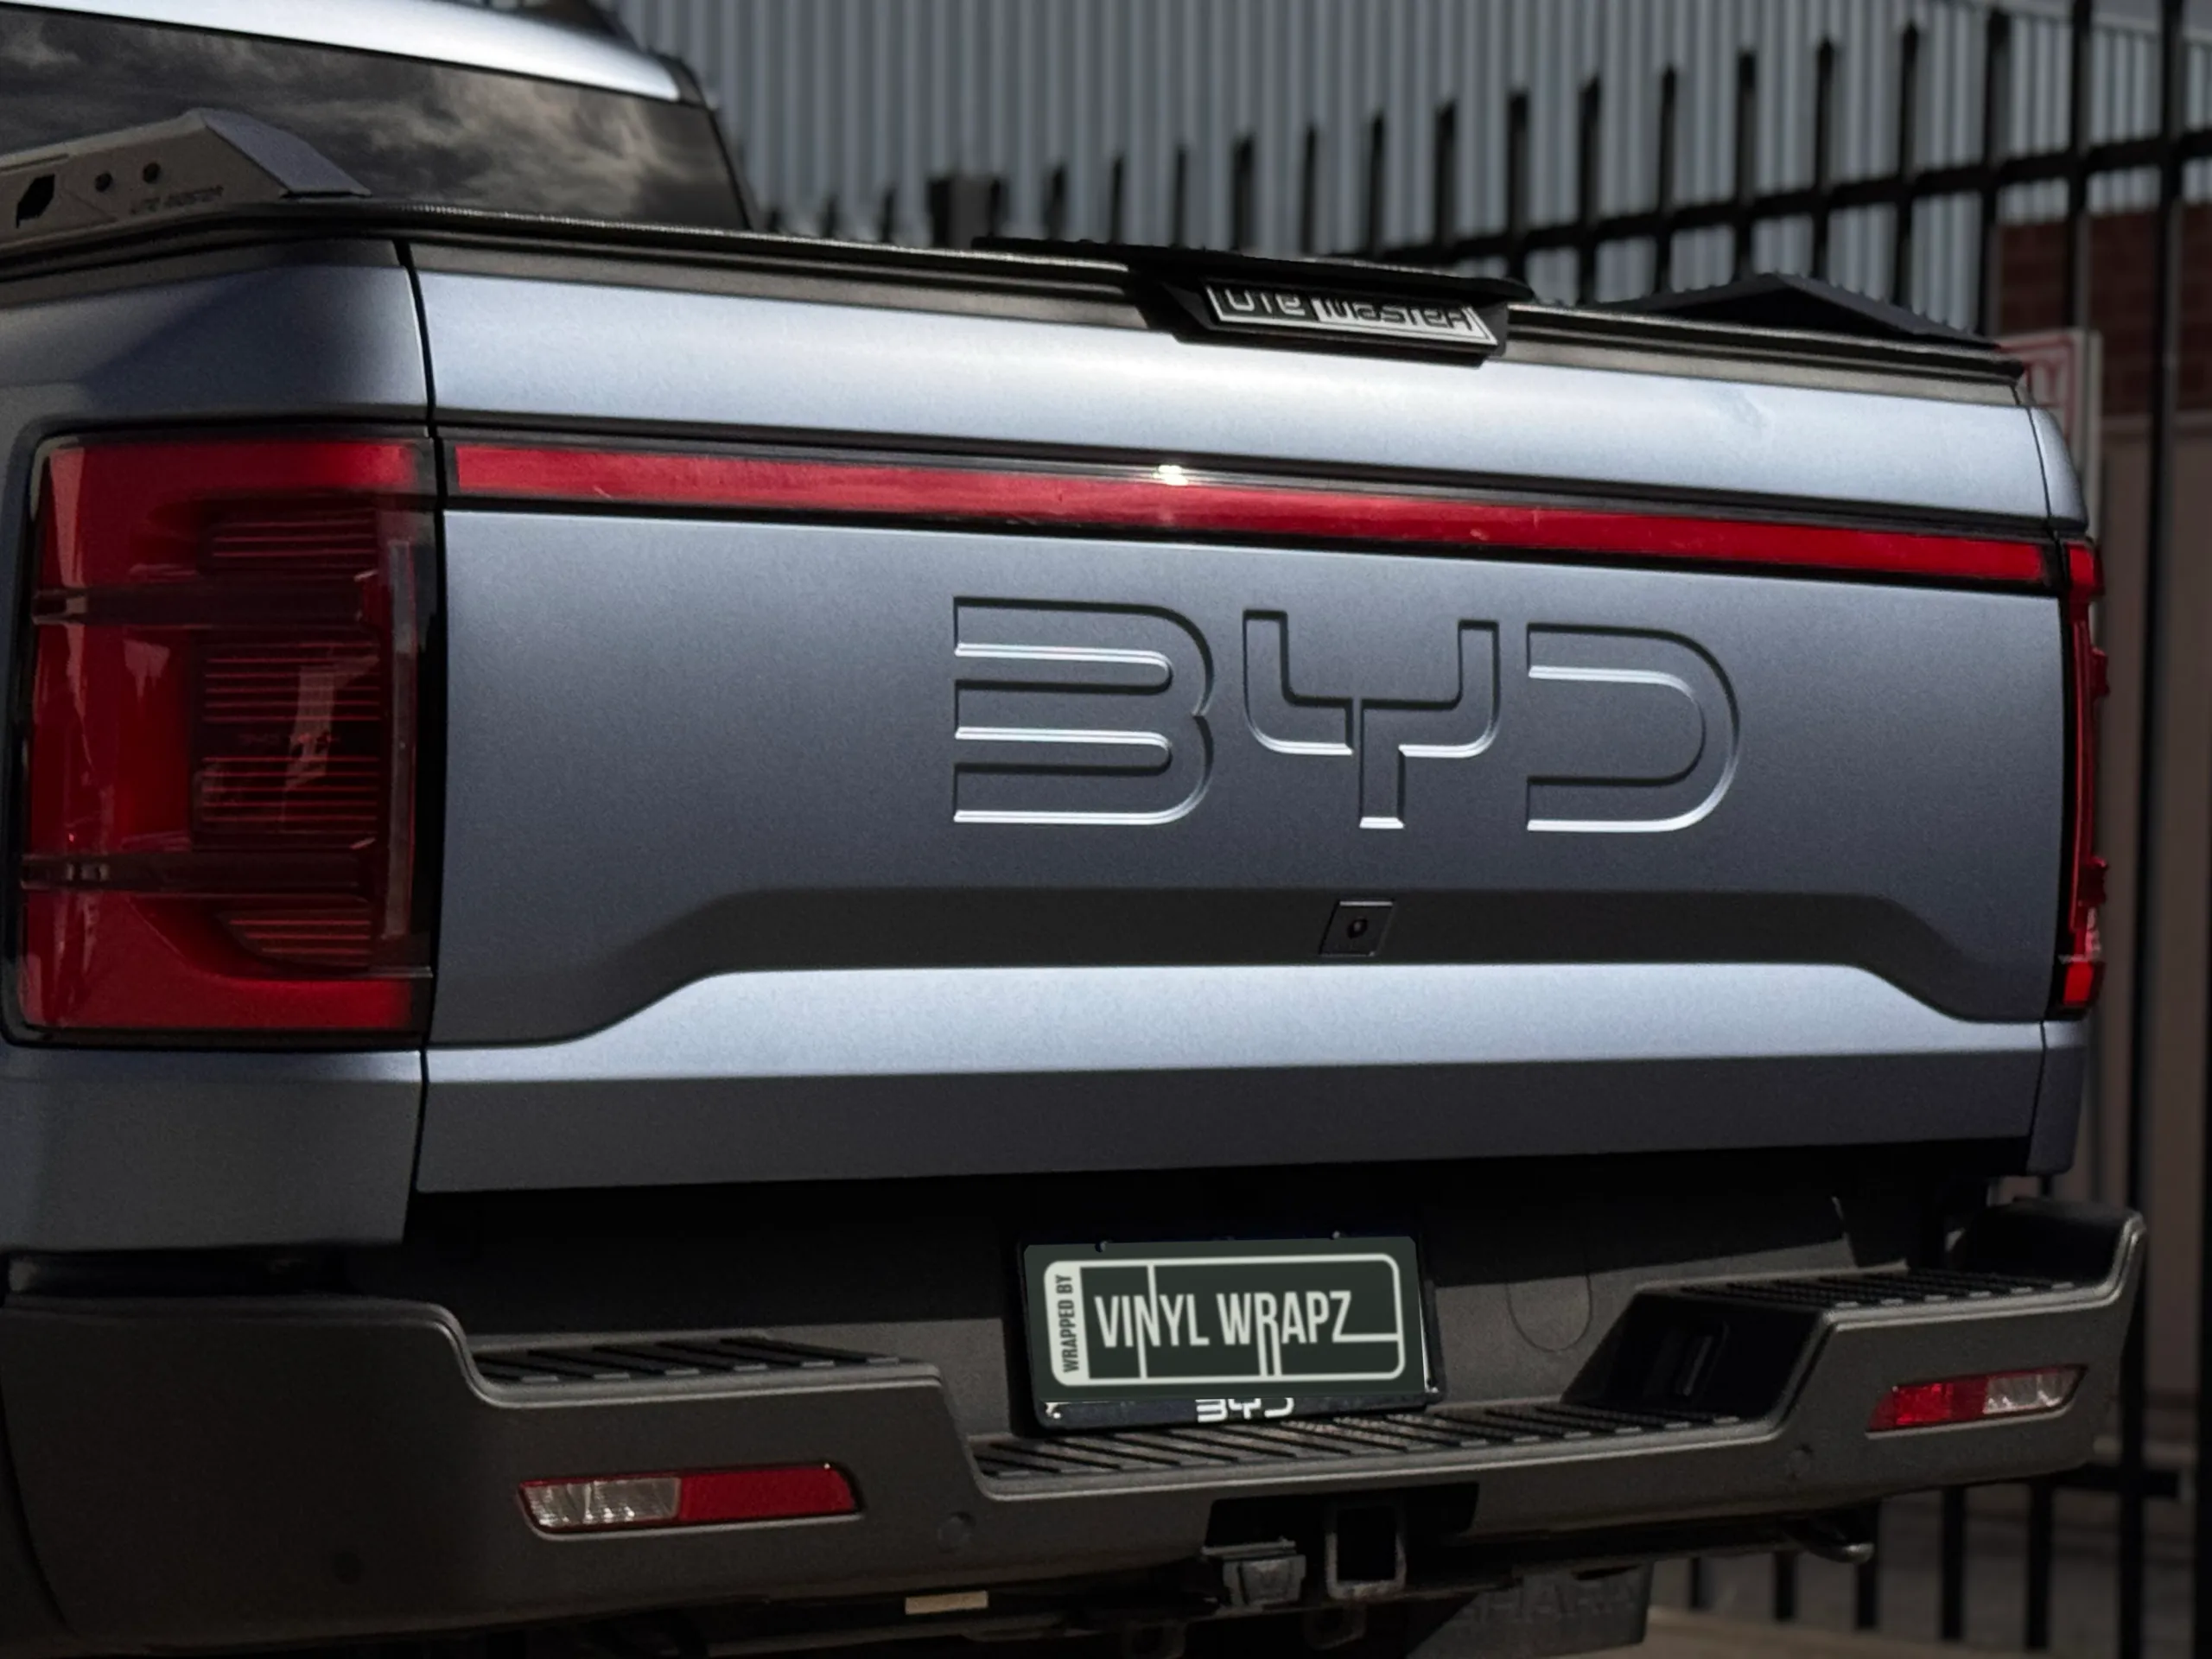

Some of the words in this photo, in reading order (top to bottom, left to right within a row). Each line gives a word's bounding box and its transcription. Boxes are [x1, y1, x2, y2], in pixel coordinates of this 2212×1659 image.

[953, 596, 1740, 832] BYD
[1055, 1274, 1073, 1294] BY
[1058, 1299, 1079, 1373] WRAPPED
[1093, 1289, 1210, 1352] VINYL
[1215, 1289, 1352, 1350] WRAPZ
